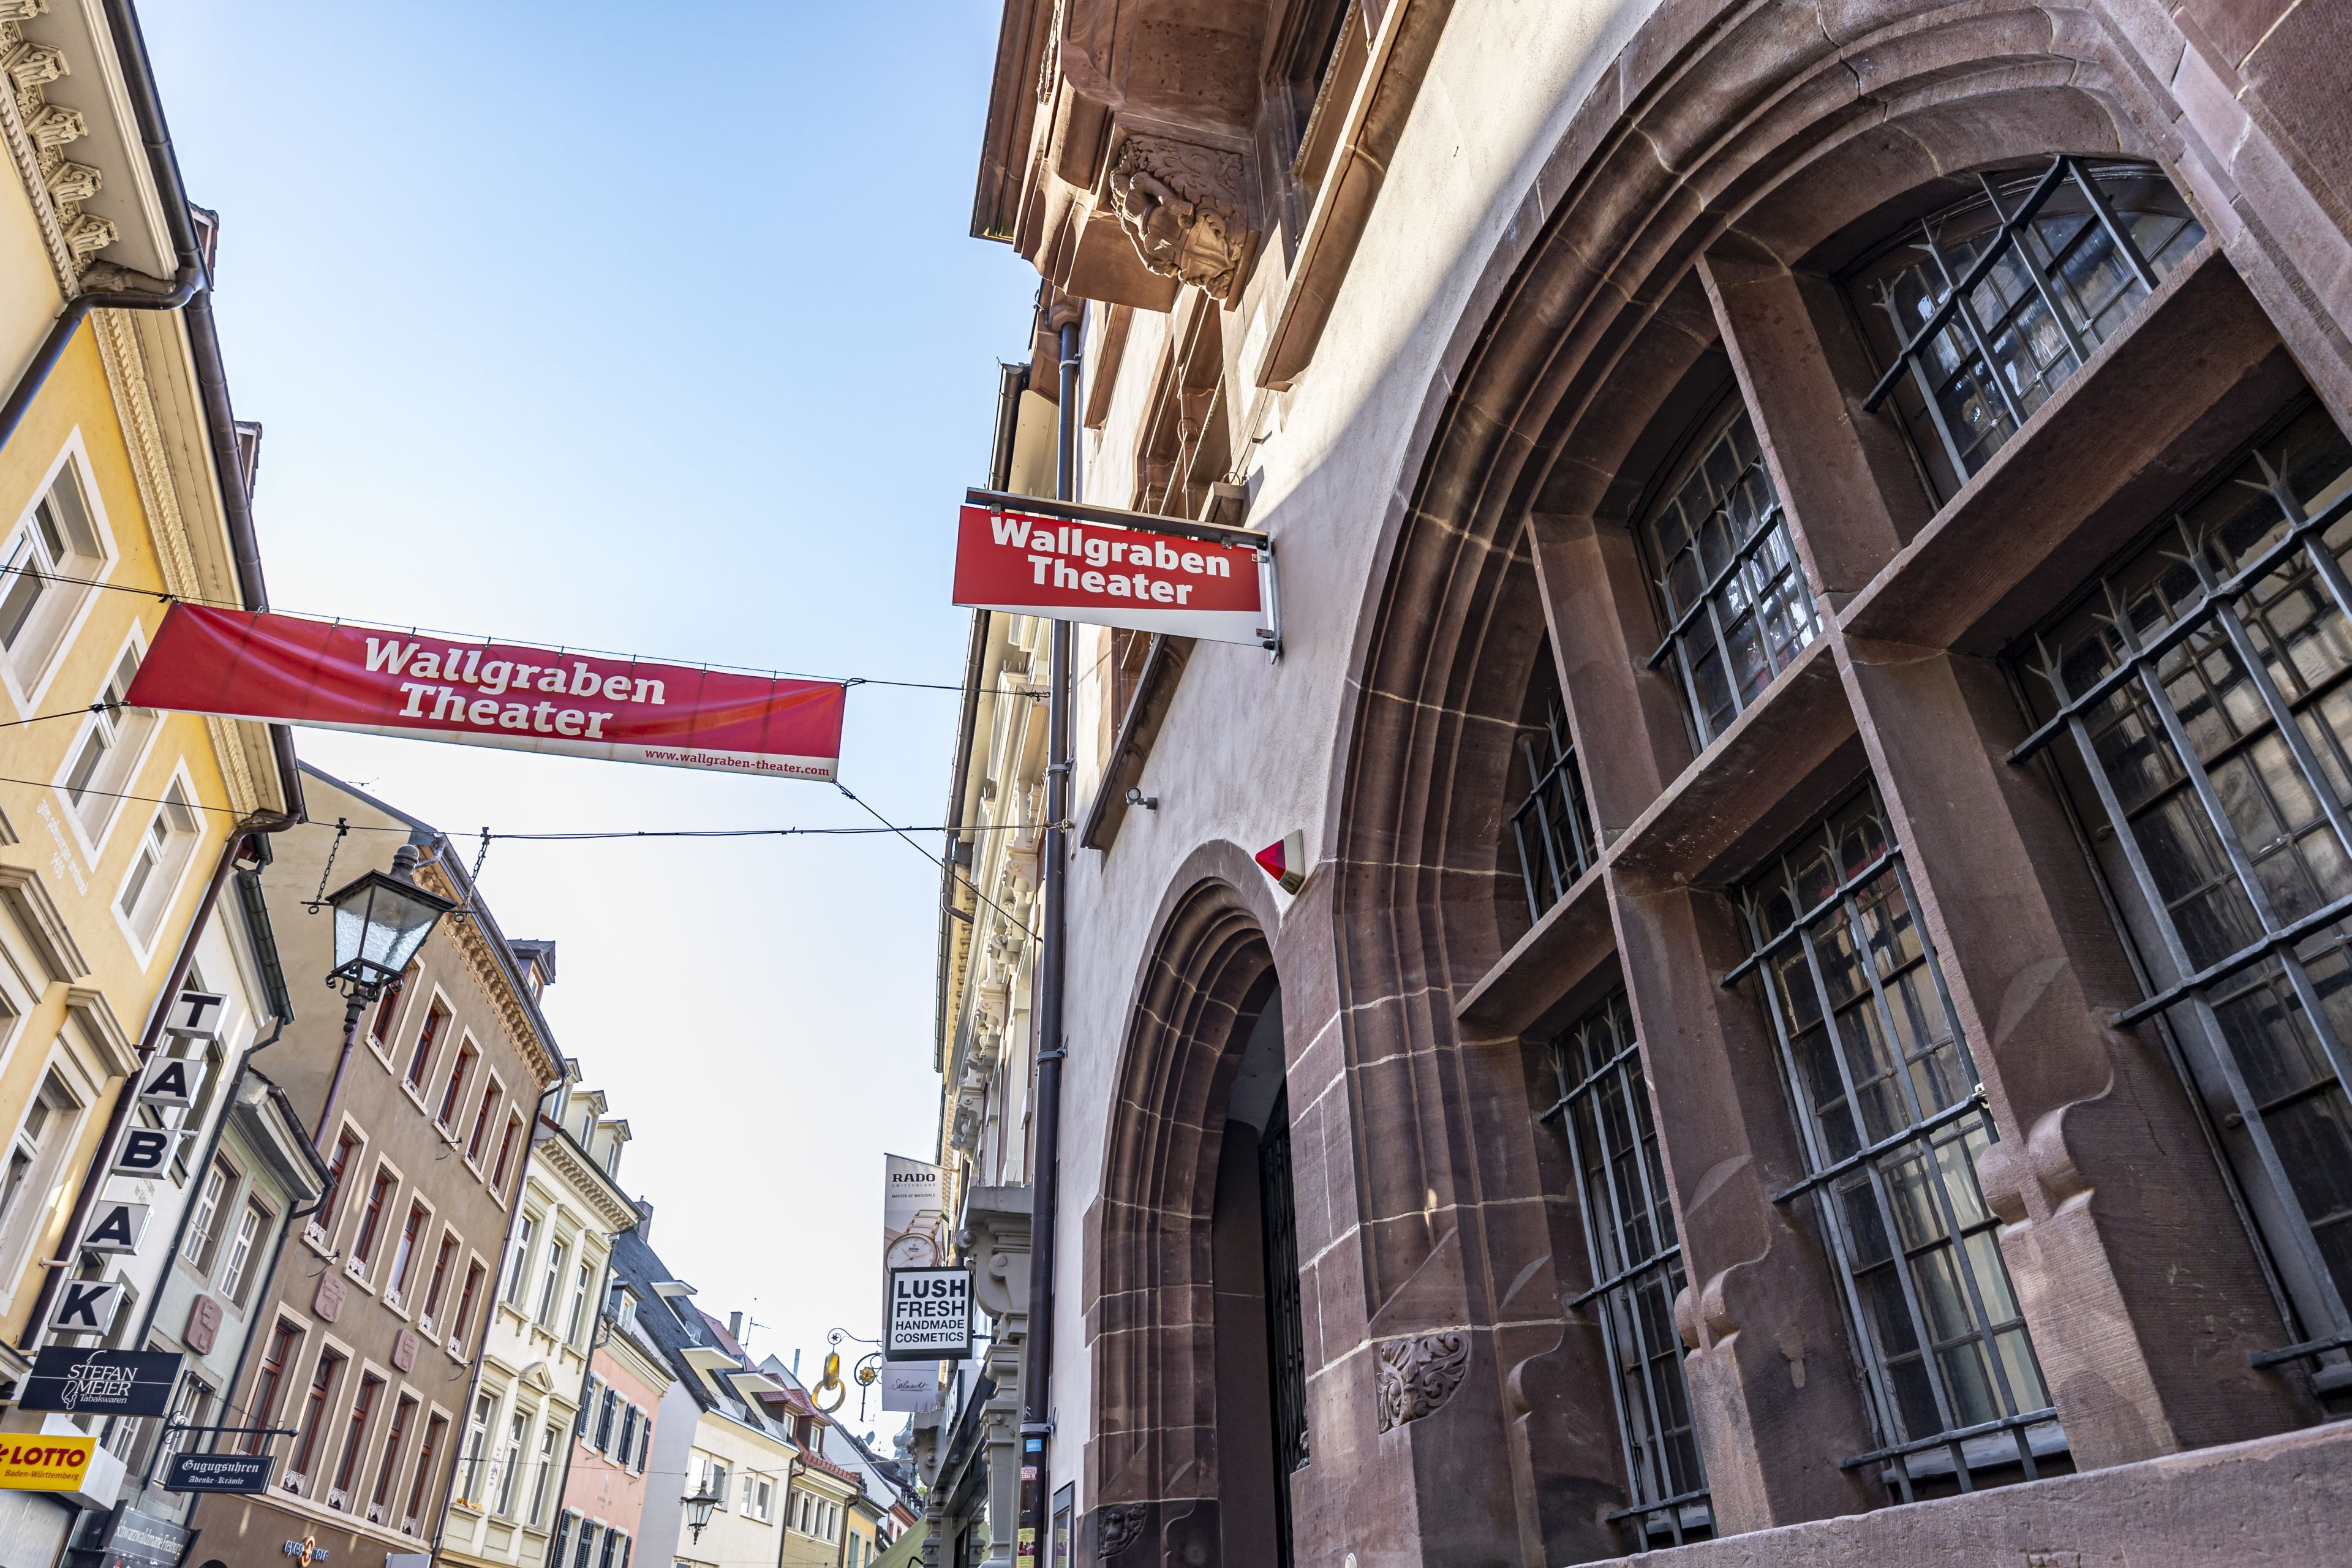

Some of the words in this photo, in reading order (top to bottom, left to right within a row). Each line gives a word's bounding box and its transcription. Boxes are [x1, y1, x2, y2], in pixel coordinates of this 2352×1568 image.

[990, 516, 1230, 578] Wallgraben
[1027, 555, 1193, 605] Theater
[366, 637, 666, 705] Wallgraben
[399, 682, 614, 739] Theater
[645, 749, 829, 777] www.wallgraben-theater.com
[57, 993, 222, 1327] TABAK
[892, 1174, 935, 1183] RADO
[897, 1279, 966, 1298] LUSH
[896, 1300, 965, 1317] FRESH
[895, 1319, 965, 1330] HANDMADE
[895, 1332, 964, 1343] COSMETICS
[67, 1364, 138, 1382] STEFAN
[74, 1380, 132, 1396] MEIER
[80, 1394, 127, 1404] Tabakwaren
[9, 1446, 86, 1468] LOTTO
[4, 1469, 80, 1481] Baden-Württemberg
[182, 1460, 260, 1474] Gugugsuhren
[164, 1534, 184, 1561] Freiburg
[284, 1540, 304, 1558] eyes
[310, 1547, 329, 1562] more
